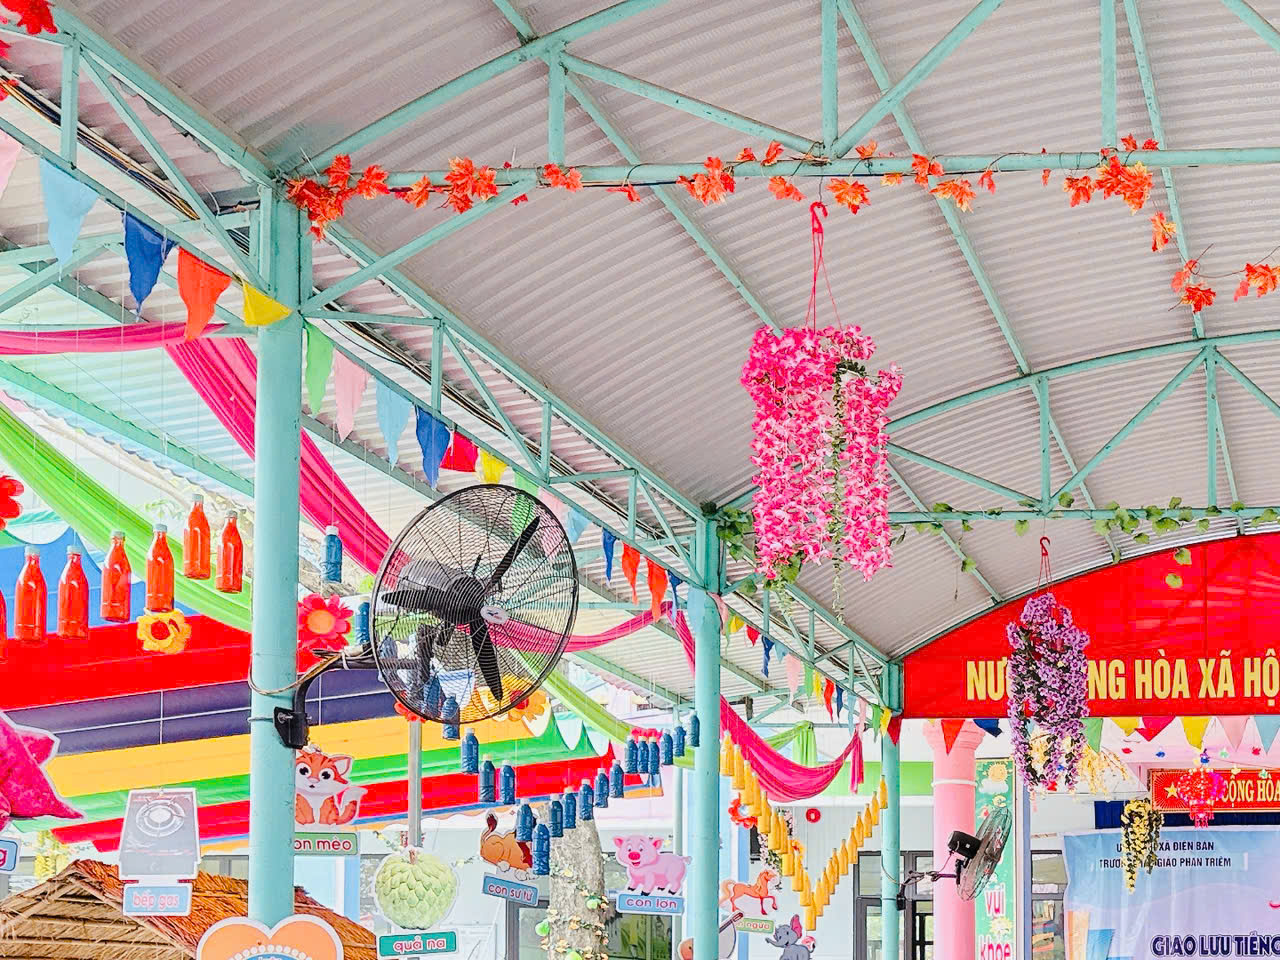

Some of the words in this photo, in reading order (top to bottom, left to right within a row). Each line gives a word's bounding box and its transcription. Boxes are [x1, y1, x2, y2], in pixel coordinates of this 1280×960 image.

[1135, 648, 1190, 700] HÒA
[1198, 650, 1236, 699] XÃ
[1221, 774, 1255, 808] CỘNG
[294, 839, 312, 850] on
[316, 836, 352, 851] mèo
[1179, 857, 1203, 868] PHAN
[133, 889, 154, 909] bếp
[159, 893, 179, 910] gas
[488, 884, 507, 897] con
[985, 883, 1005, 916] vui
[626, 898, 651, 908] con
[394, 935, 422, 954] quả
[427, 938, 446, 950] na
[1151, 934, 1198, 957] GIAO
[1199, 933, 1233, 957] LƯU
